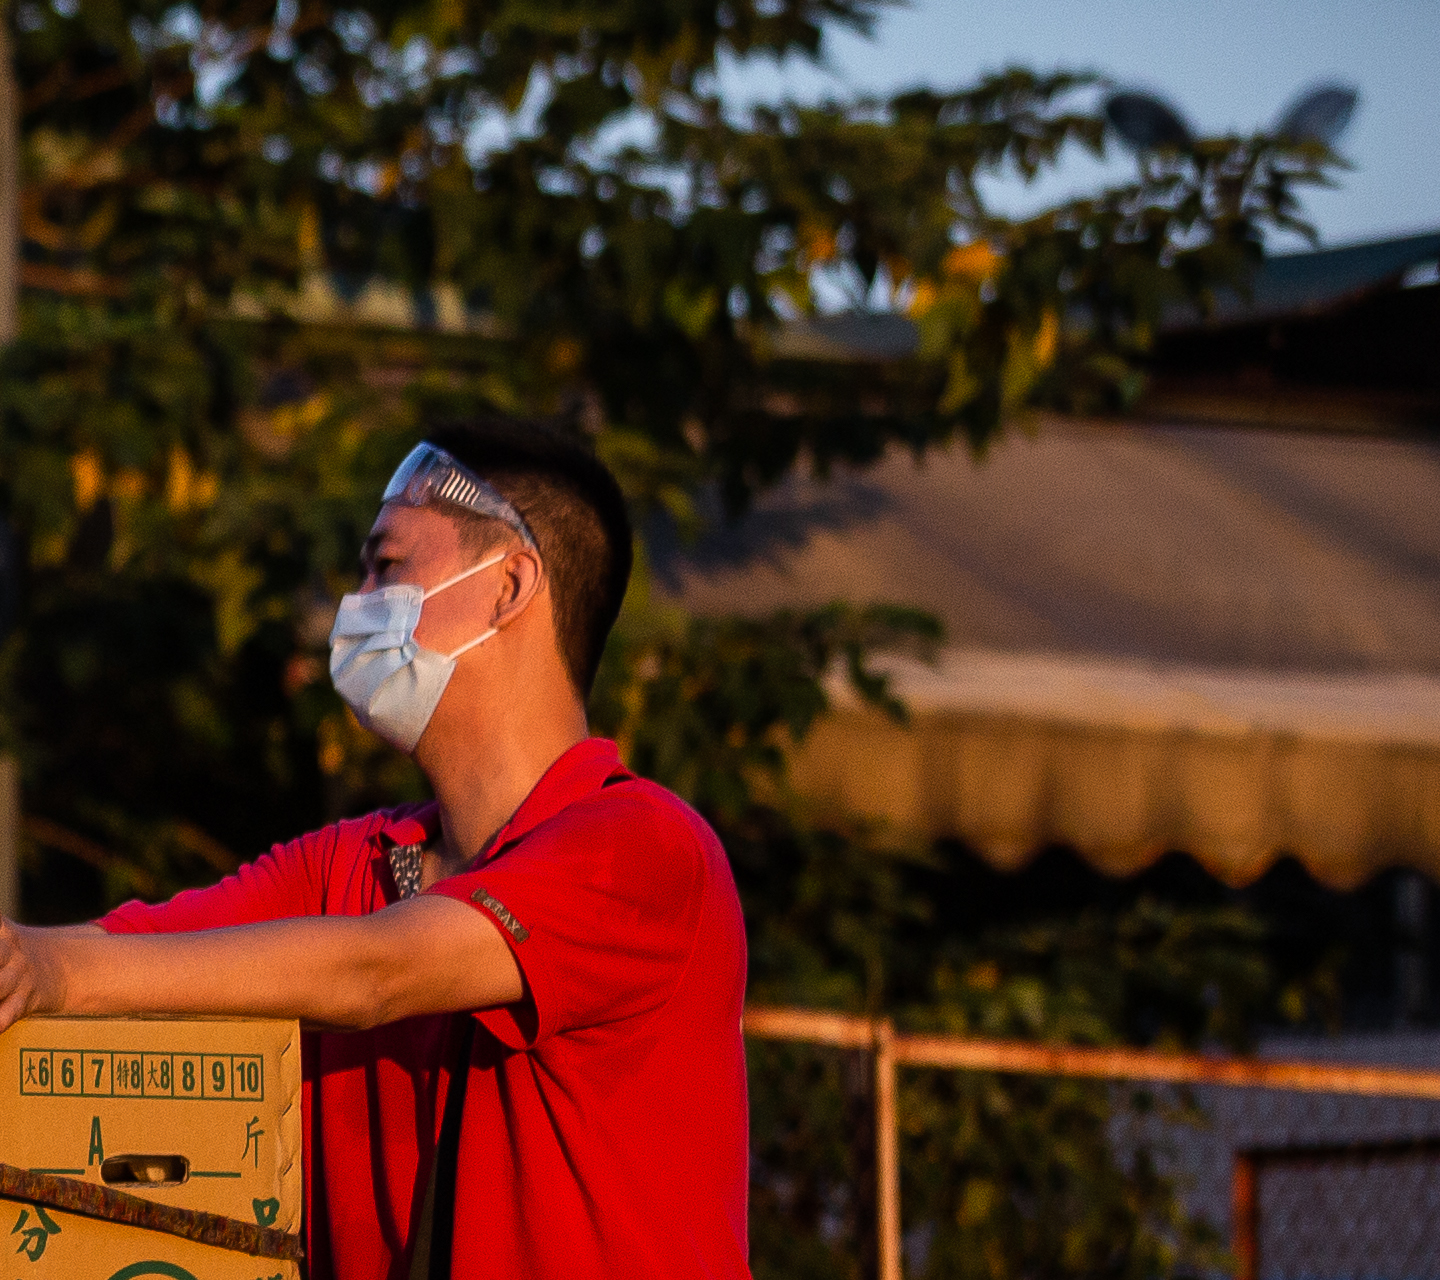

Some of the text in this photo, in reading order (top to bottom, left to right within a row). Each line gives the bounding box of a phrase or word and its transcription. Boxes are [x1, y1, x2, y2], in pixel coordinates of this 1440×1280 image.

[60, 1057, 75, 1088] 6
[90, 1057, 105, 1089] 7
[181, 1058, 196, 1093] 8
[210, 1059, 226, 1092] 9
[234, 1059, 260, 1093] 10
[87, 1114, 265, 1169] A 斤
